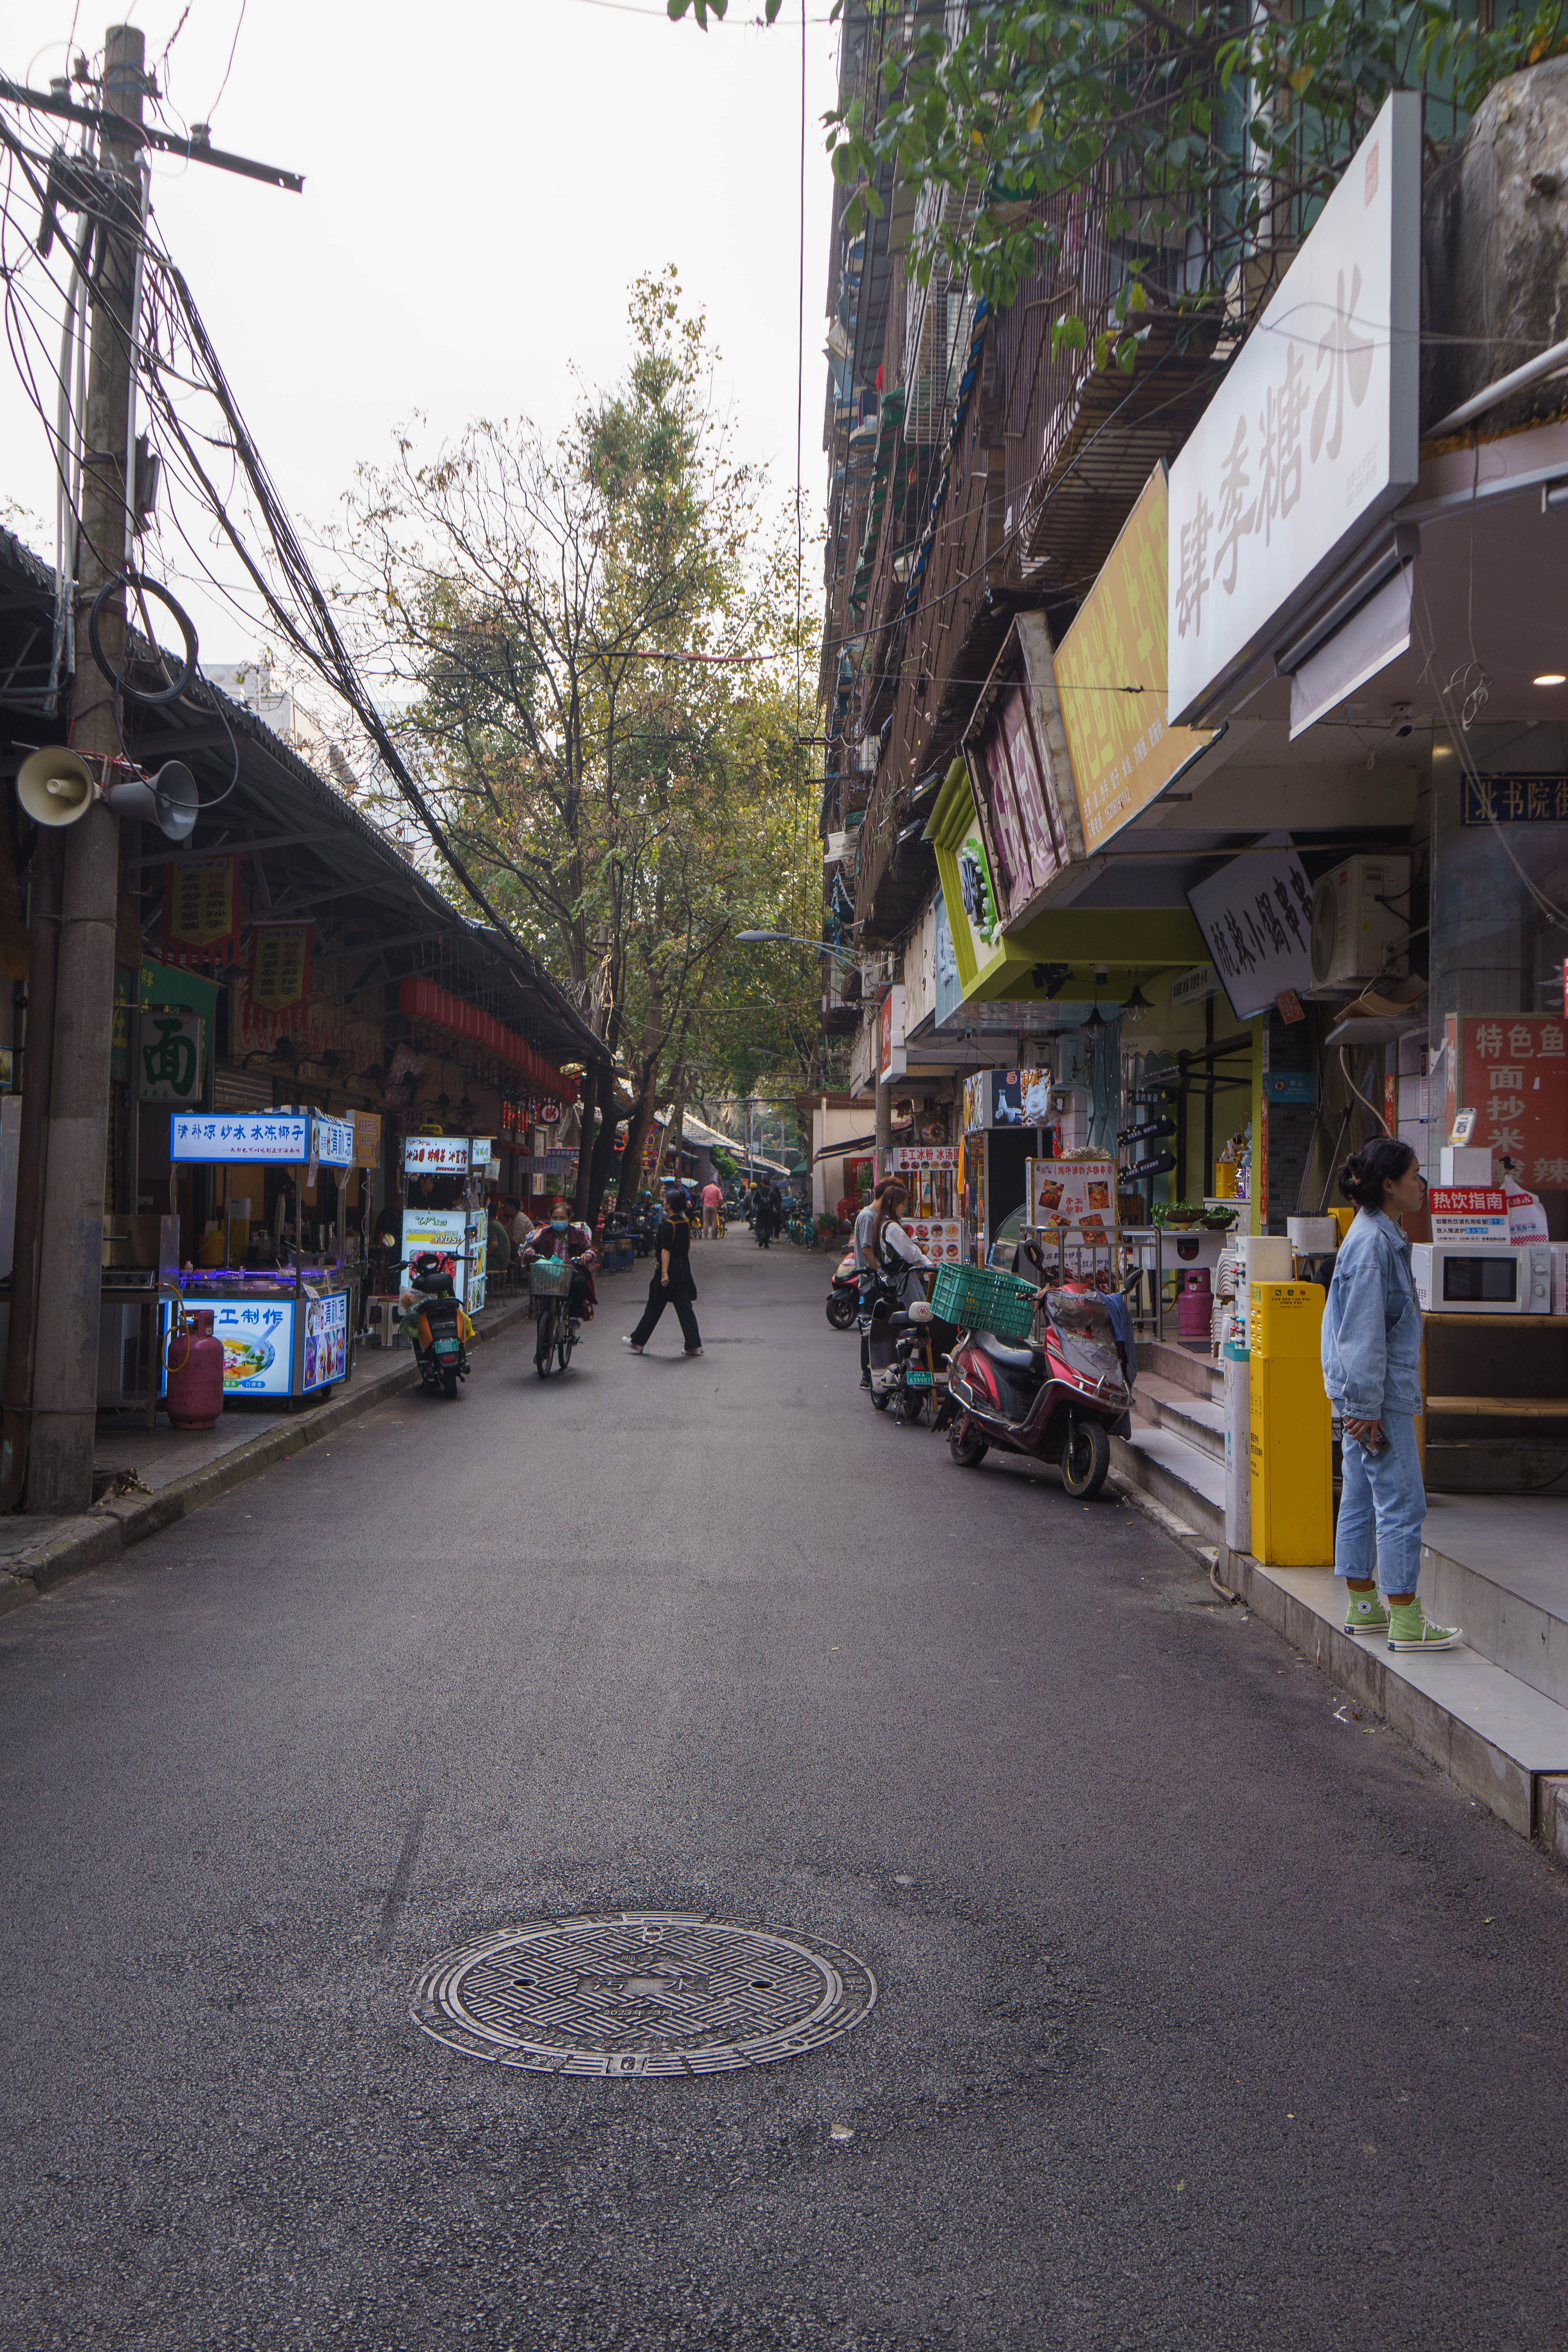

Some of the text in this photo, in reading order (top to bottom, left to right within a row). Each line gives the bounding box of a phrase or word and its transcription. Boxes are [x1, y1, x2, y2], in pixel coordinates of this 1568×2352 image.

[1176, 262, 1376, 638] 肆季糖水
[1058, 580, 1148, 796] 特色鱼米线
[1476, 1024, 1566, 1058] 特色鱼
[143, 1018, 197, 1096] 面
[1487, 1065, 1526, 1090] 面
[1486, 1096, 1526, 1121] 抄
[178, 1123, 304, 1141] 清补凉 炒冰 冰冻椰子
[1488, 1127, 1525, 1152] 米
[900, 1148, 960, 1161] 手工冰粉 冰汤圆
[1434, 1192, 1503, 1210] 热饮指南
[434, 1235, 461, 1244] YYDS!
[214, 1308, 283, 1325] 工制作
